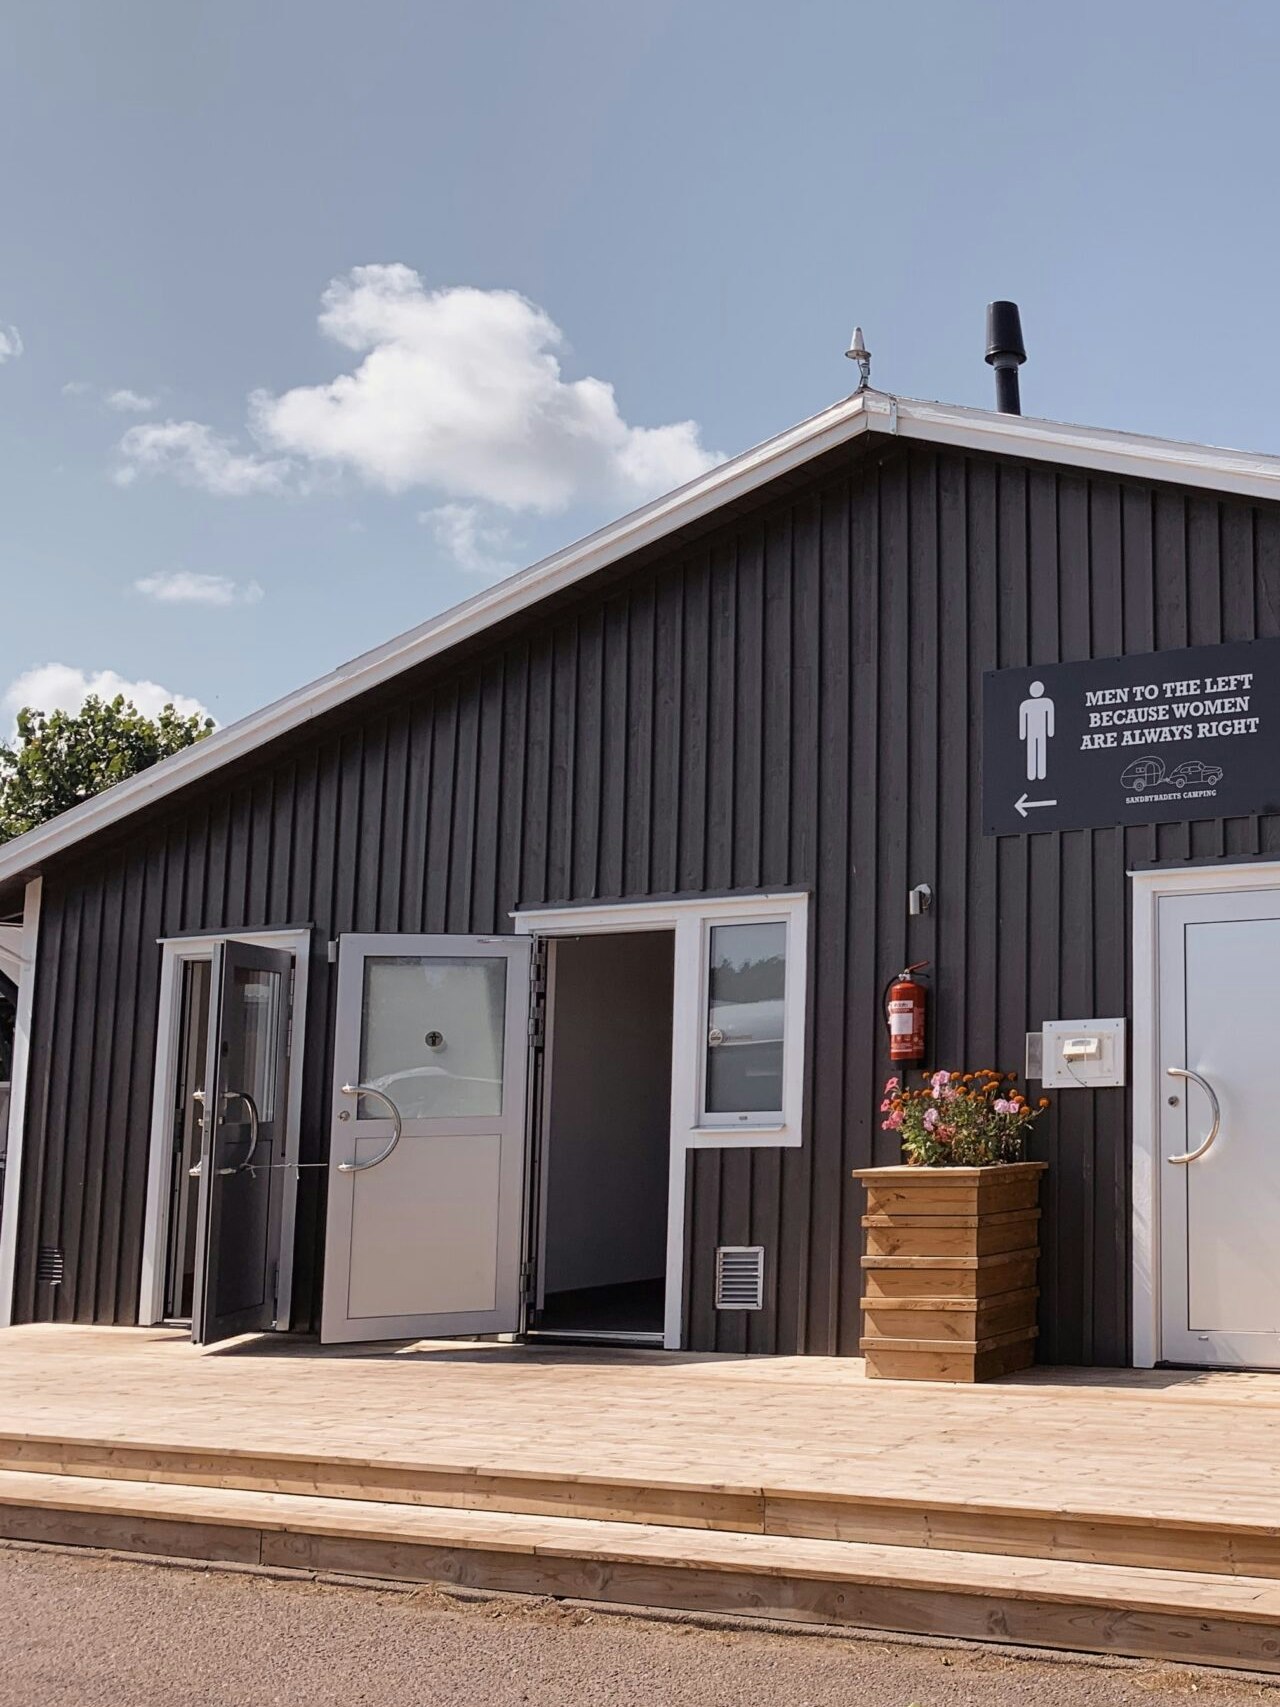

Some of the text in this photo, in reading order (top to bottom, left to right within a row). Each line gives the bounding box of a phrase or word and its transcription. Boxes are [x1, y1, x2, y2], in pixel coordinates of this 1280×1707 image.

[1085, 673, 1253, 707] MEN TO THE LEFT
[1088, 696, 1251, 728] BECAUSE WOMEN
[1079, 717, 1260, 750] ARE ALWAYS RIGHT
[1182, 789, 1217, 799] CAMPING
